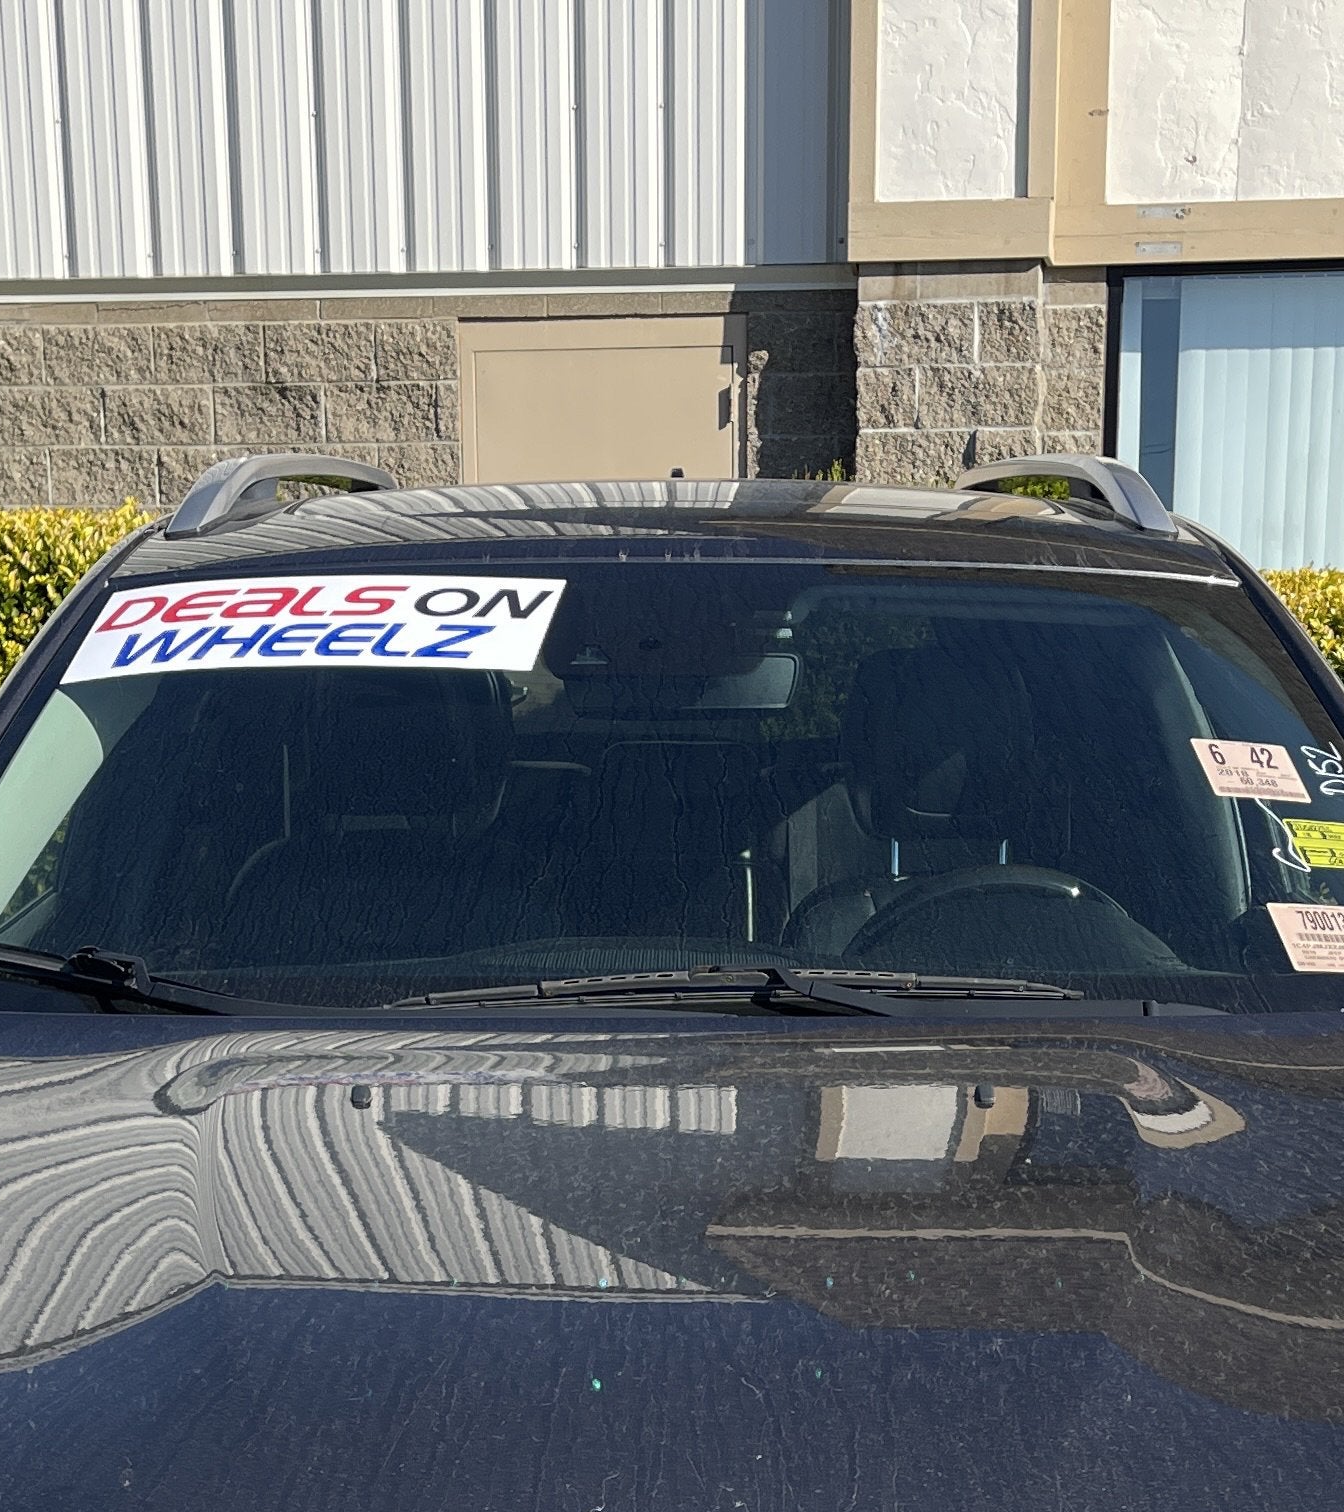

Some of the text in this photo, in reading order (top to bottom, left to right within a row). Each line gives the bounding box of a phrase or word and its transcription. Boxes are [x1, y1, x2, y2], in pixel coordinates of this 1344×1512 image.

[94, 586, 555, 634] DEALS ON
[111, 623, 497, 669] WHEELZ
[1208, 743, 1279, 769] 6 42
